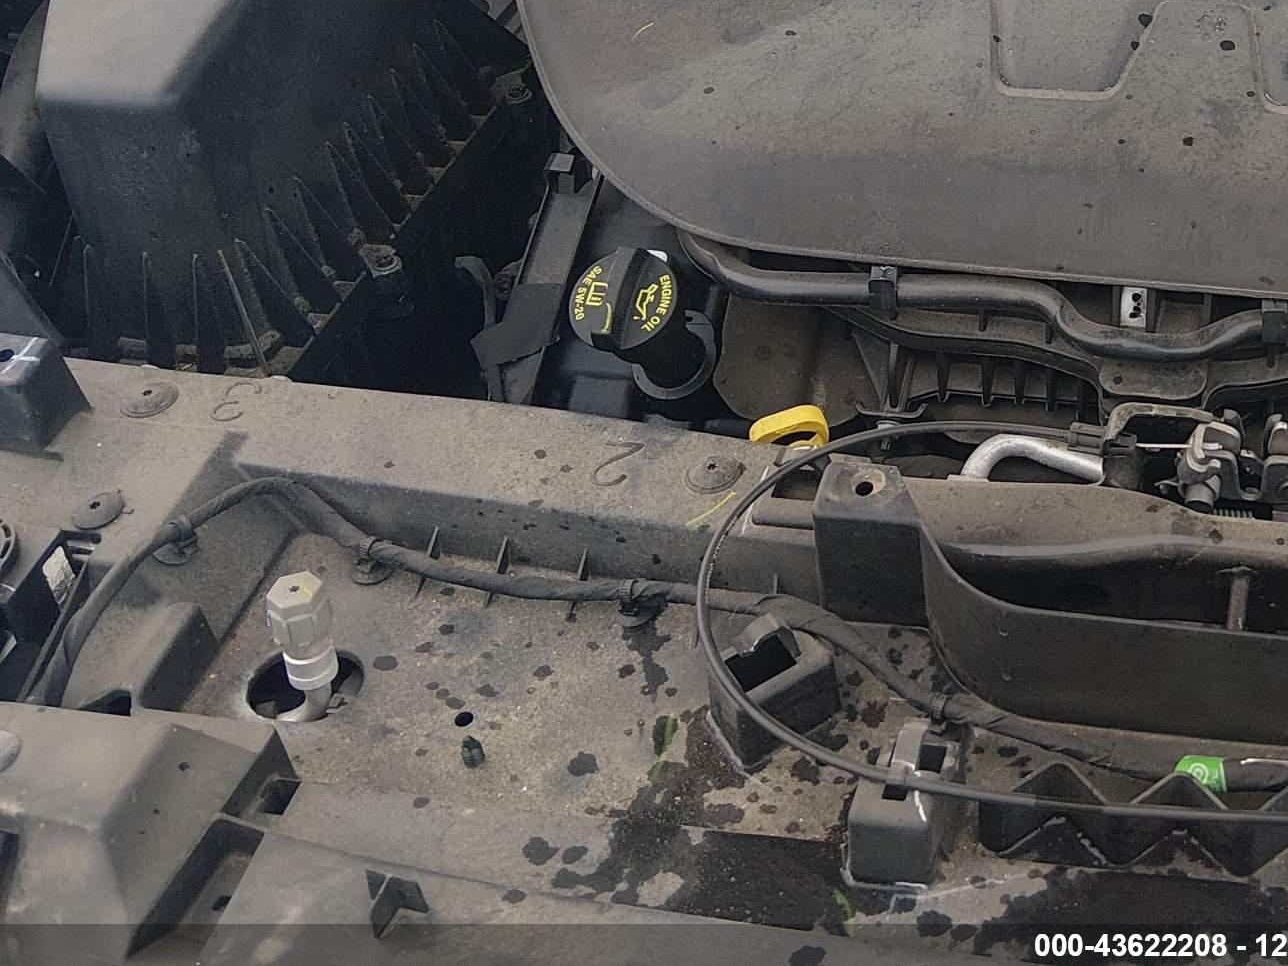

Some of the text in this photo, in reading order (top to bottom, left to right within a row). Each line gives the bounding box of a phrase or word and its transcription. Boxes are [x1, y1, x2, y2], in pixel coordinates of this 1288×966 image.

[574, 265, 603, 321] SAE 5W-20
[640, 274, 671, 332] ENGINE OIL
